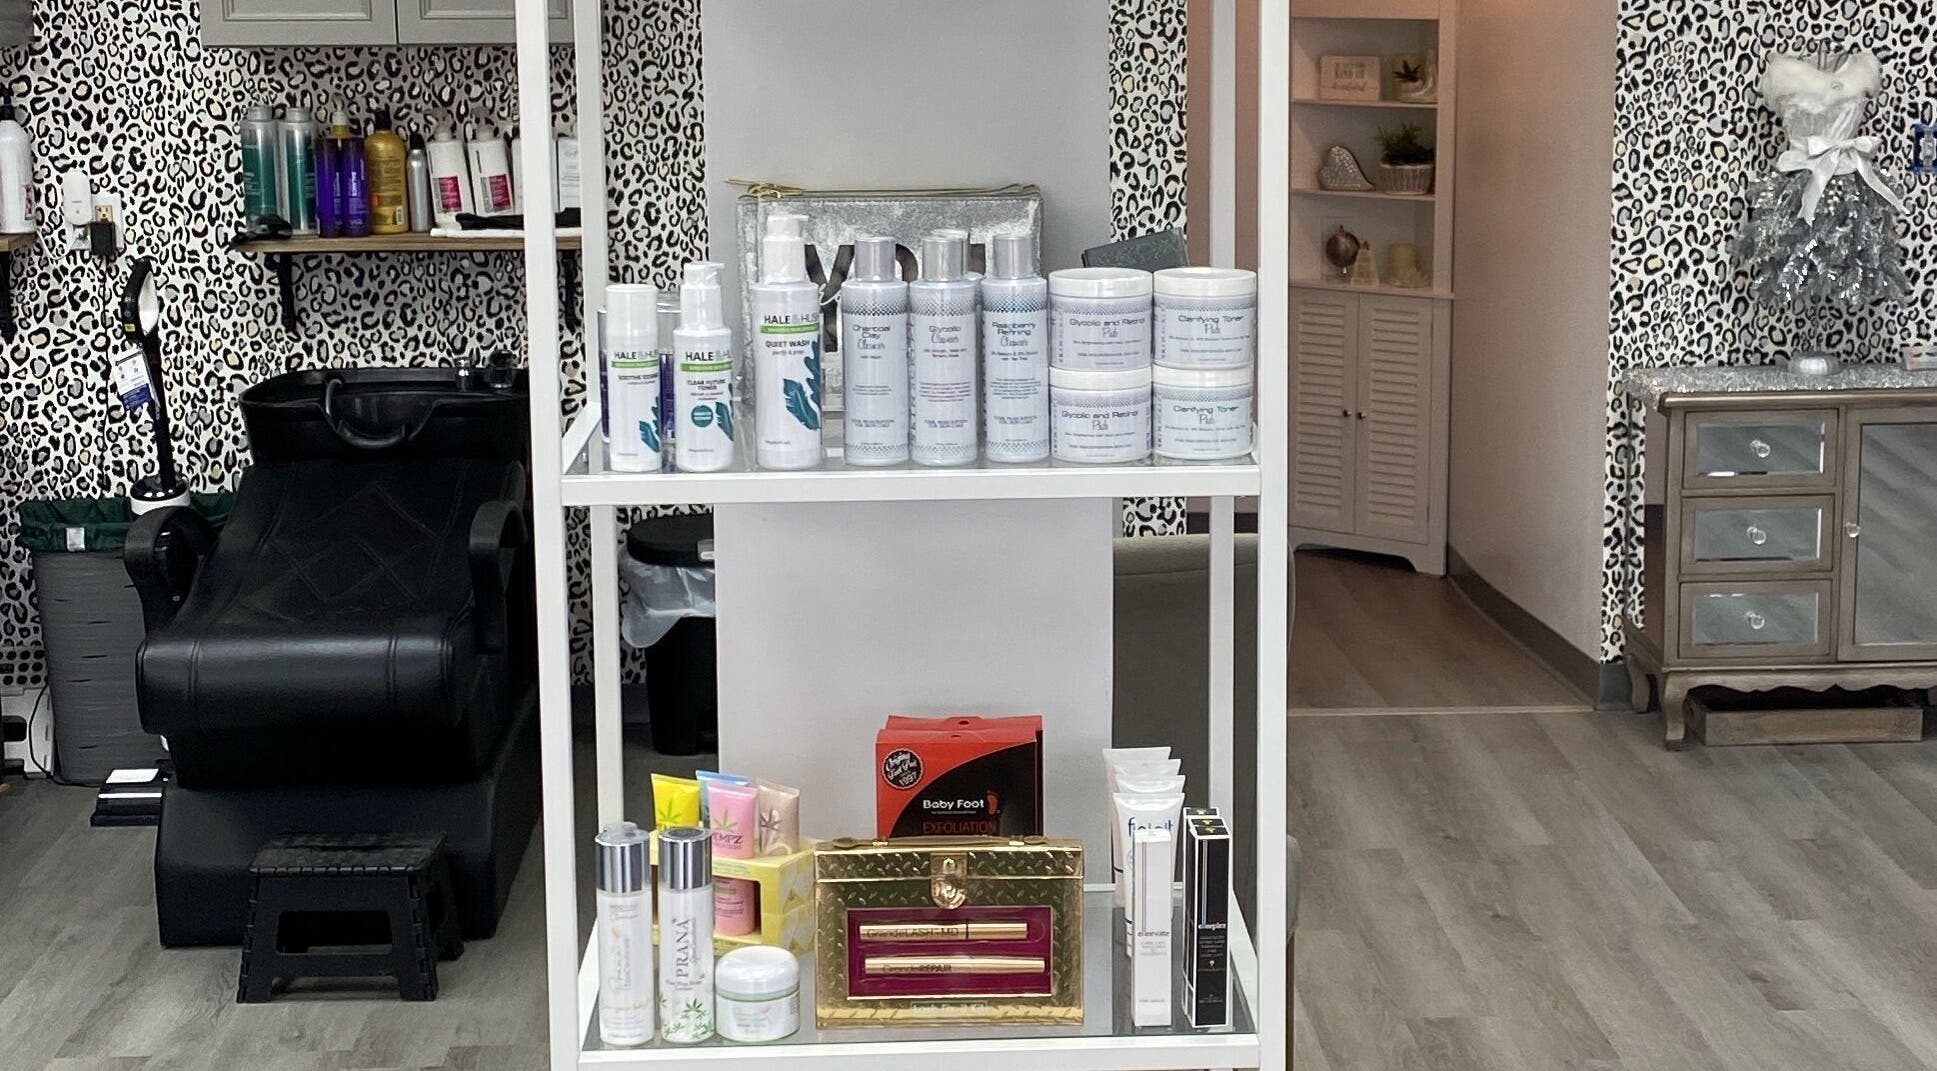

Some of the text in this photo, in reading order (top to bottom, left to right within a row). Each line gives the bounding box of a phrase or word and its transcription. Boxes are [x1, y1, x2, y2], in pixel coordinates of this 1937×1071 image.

[764, 314, 791, 324] HALE
[1070, 318, 1101, 326] Glycolic
[1178, 315, 1219, 323] Clarifying
[852, 323, 890, 332] Charcoal
[929, 325, 962, 333] Glycolic
[992, 321, 1036, 329] Raspberry
[861, 331, 881, 339] Clay
[765, 340, 787, 348] QUIET
[614, 351, 637, 360] HALE
[685, 351, 714, 361] HALE
[1061, 410, 1091, 418] Glycolic
[1112, 410, 1138, 418] Retinol
[1173, 405, 1214, 414] Clarifying
[899, 771, 917, 786] 1997
[922, 799, 985, 810] Baby Foot
[922, 820, 997, 834] EXFOLIATION
[676, 918, 689, 978] PRANA
